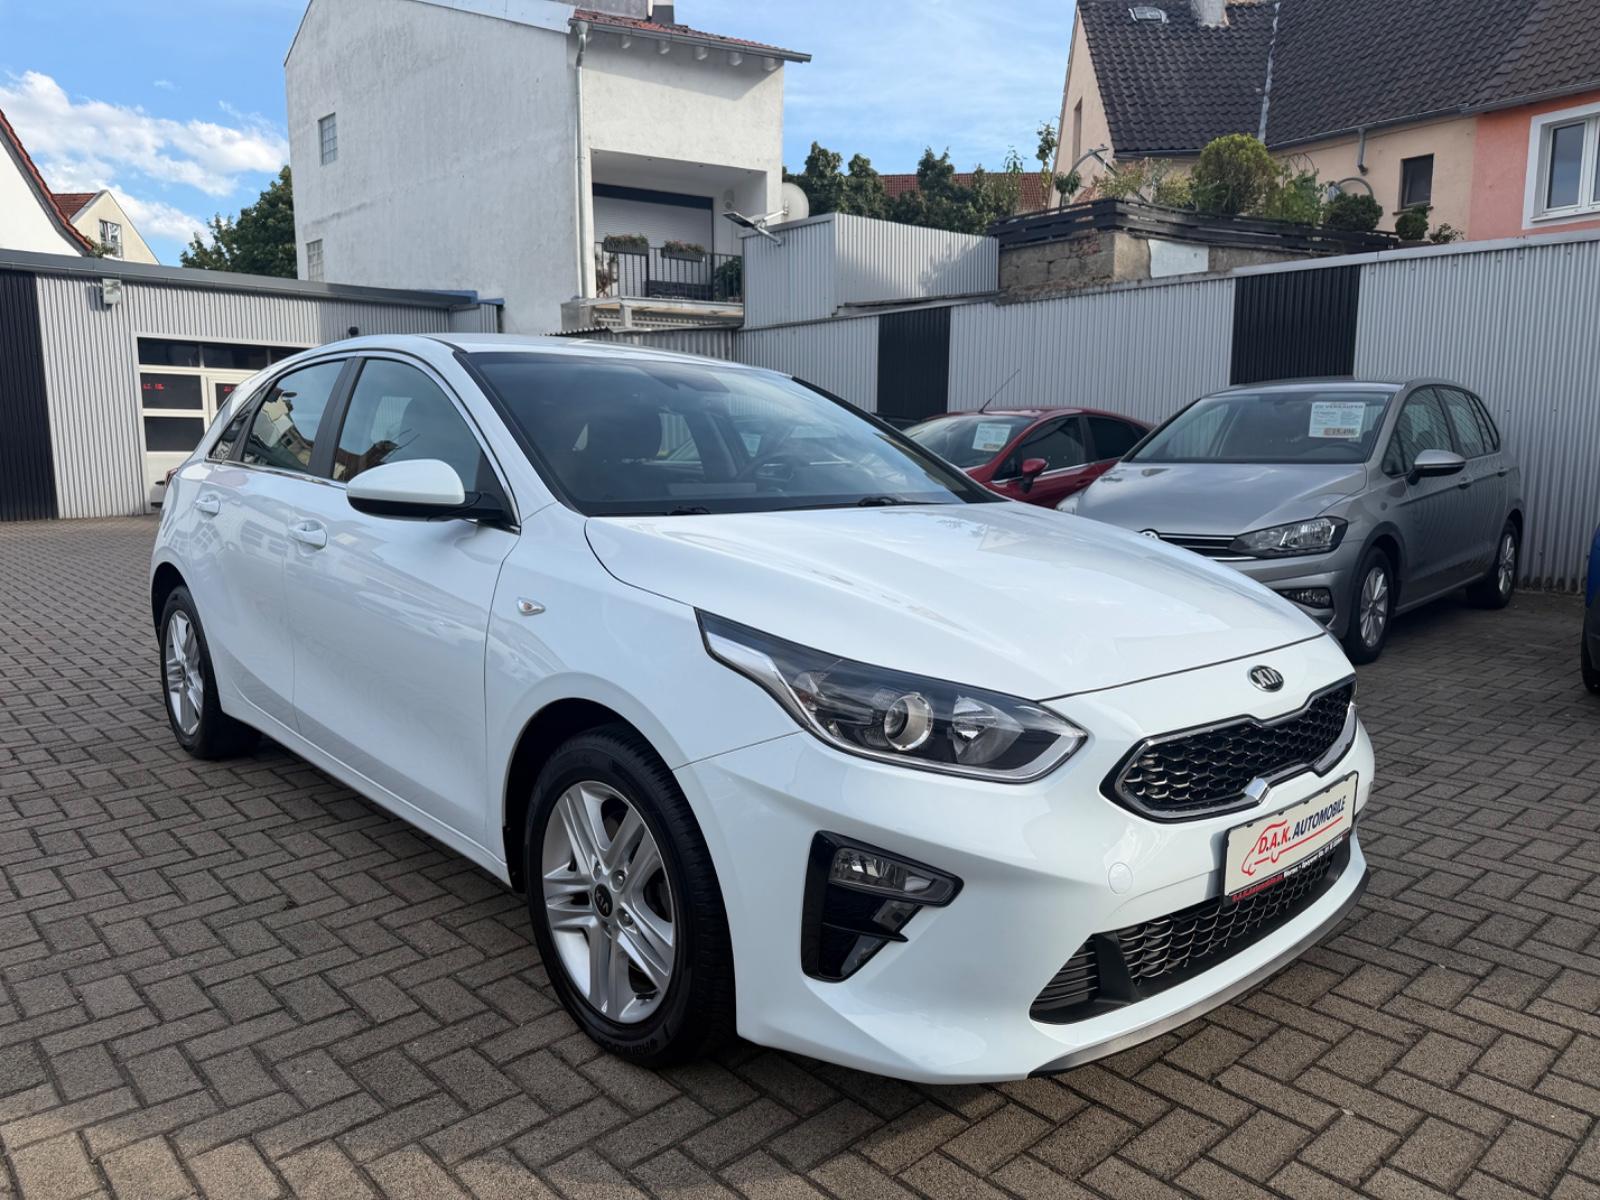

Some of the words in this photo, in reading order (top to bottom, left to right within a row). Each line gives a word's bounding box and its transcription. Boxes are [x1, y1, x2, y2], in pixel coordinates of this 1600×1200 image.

[1252, 669, 1282, 687] KIA
[1258, 826, 1291, 854] D.A.K.
[1292, 795, 1346, 840] AUTOMOBILE
